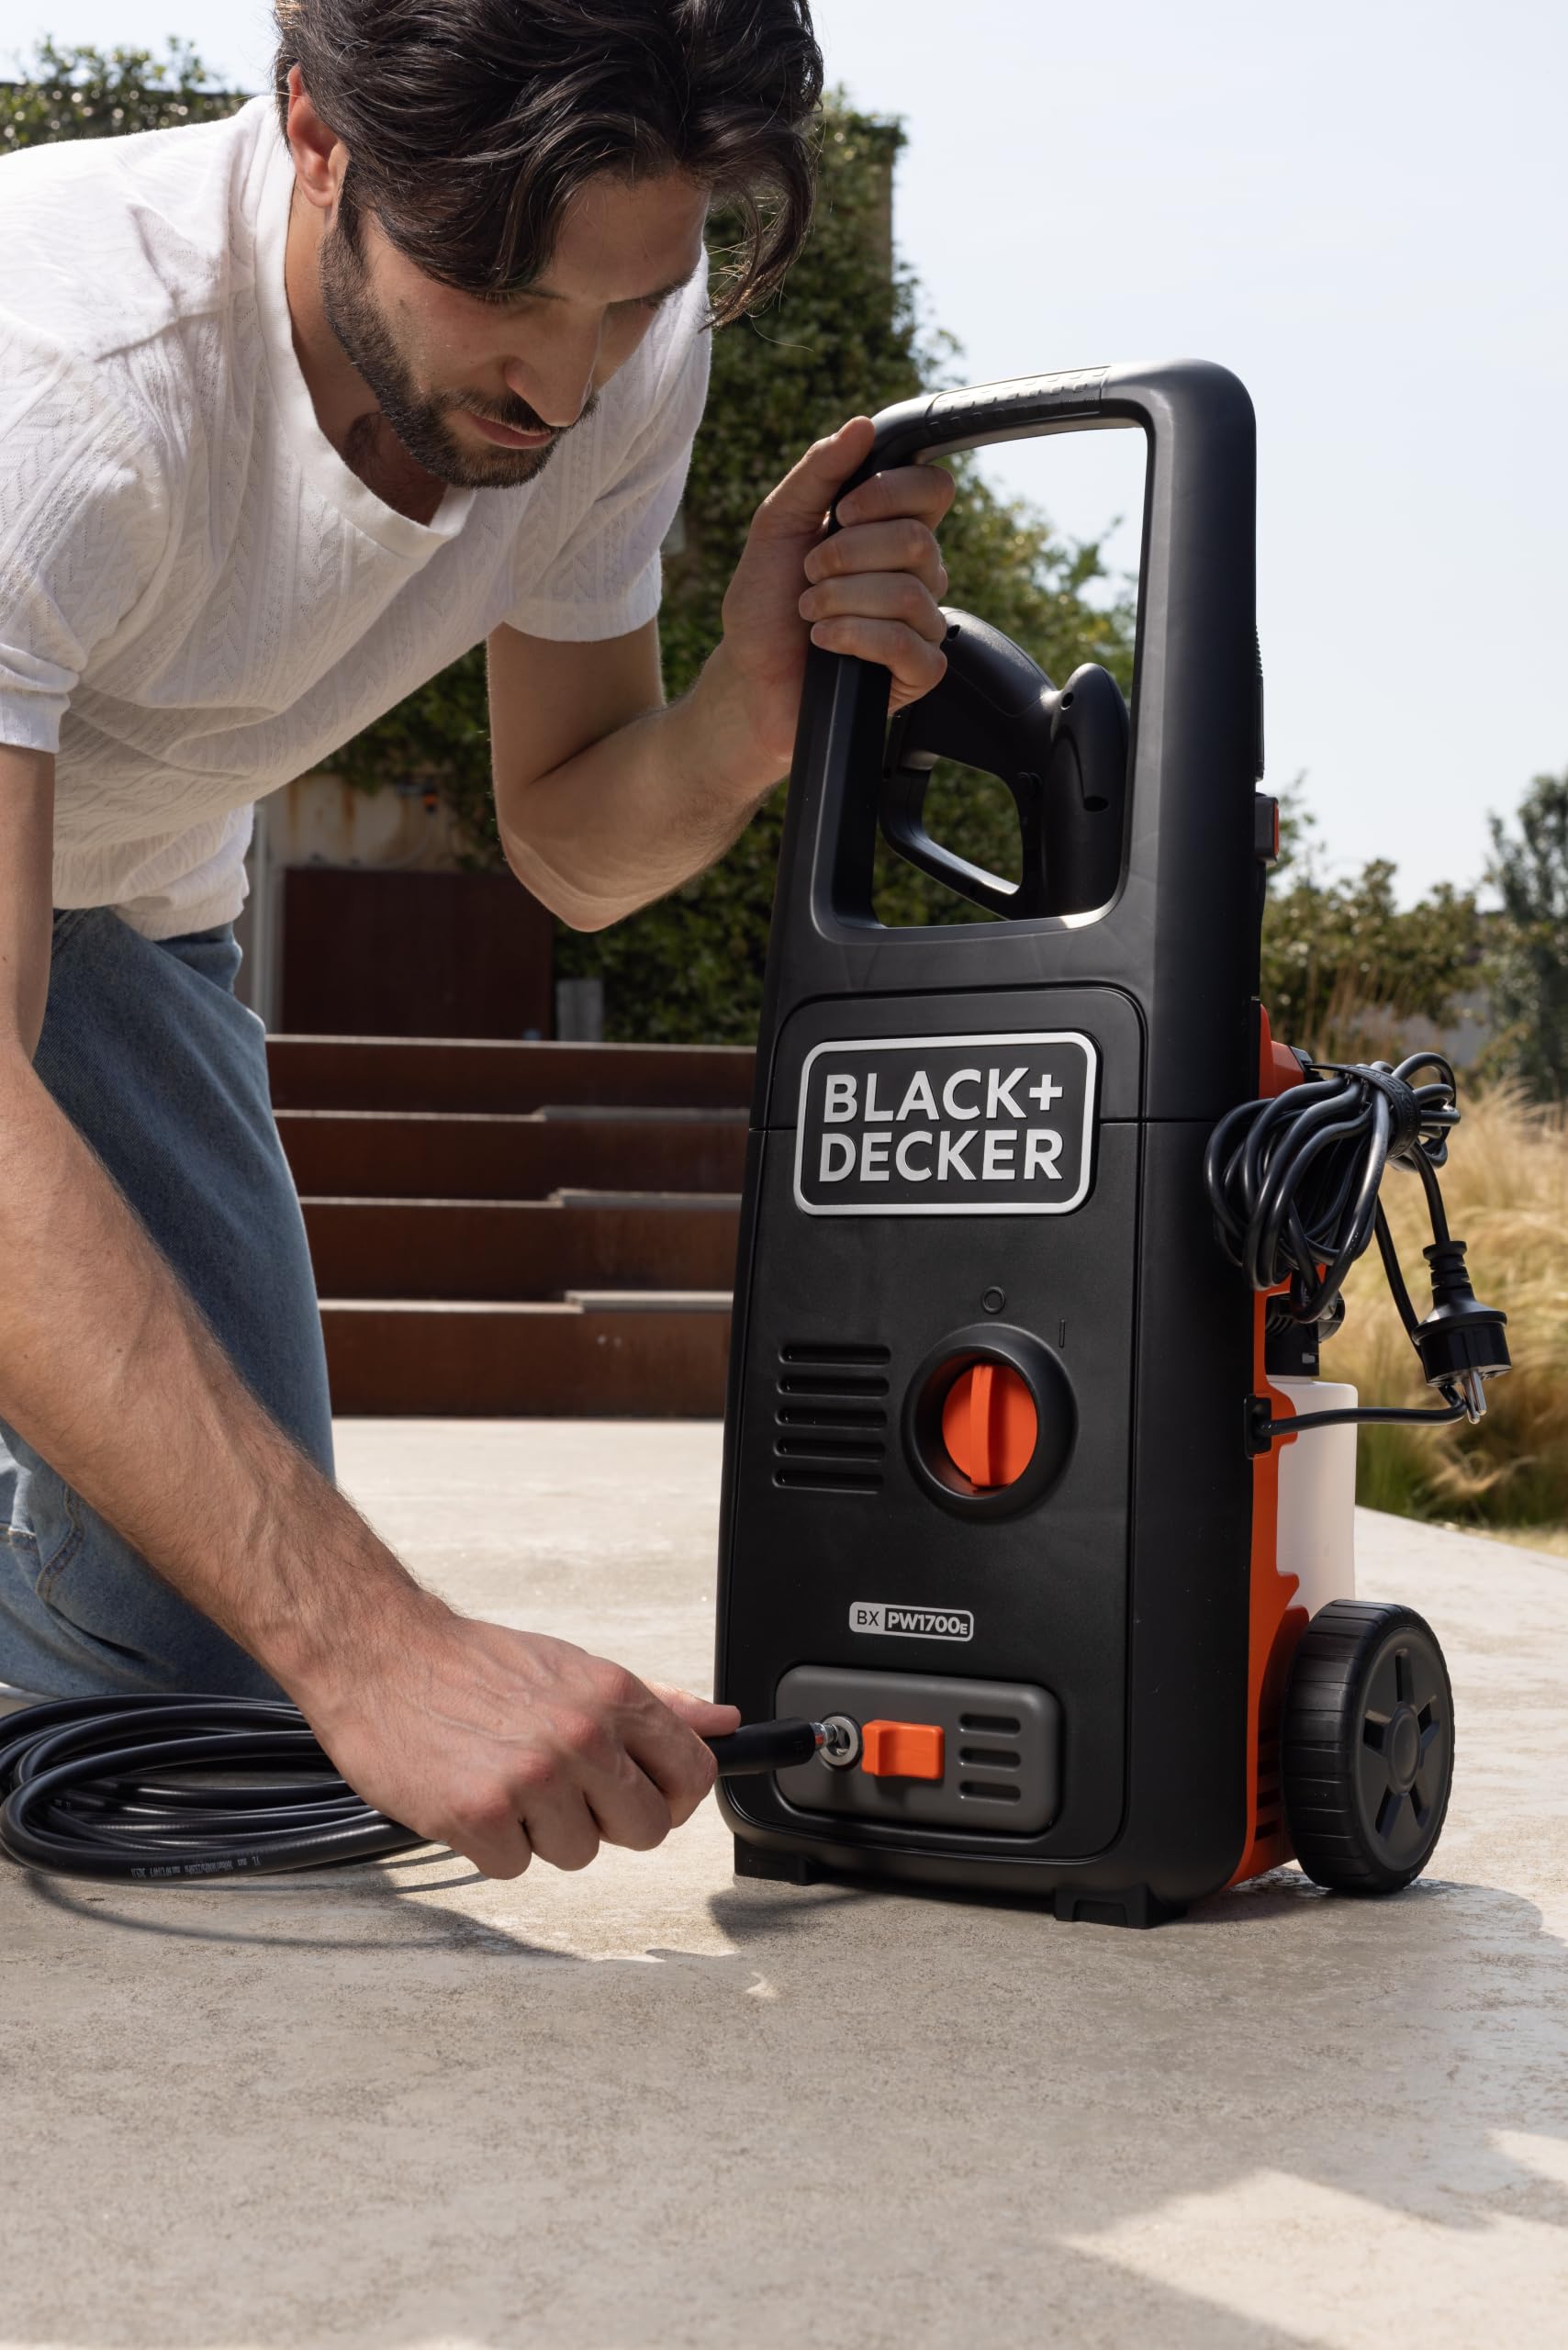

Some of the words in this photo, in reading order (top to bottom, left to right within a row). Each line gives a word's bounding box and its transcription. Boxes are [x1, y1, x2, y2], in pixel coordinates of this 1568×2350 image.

[823, 1068, 1063, 1123] BLACK+
[819, 1128, 1064, 1181] DECKER
[857, 1609, 879, 1627] BX
[888, 1612, 969, 1634] PW1700E
